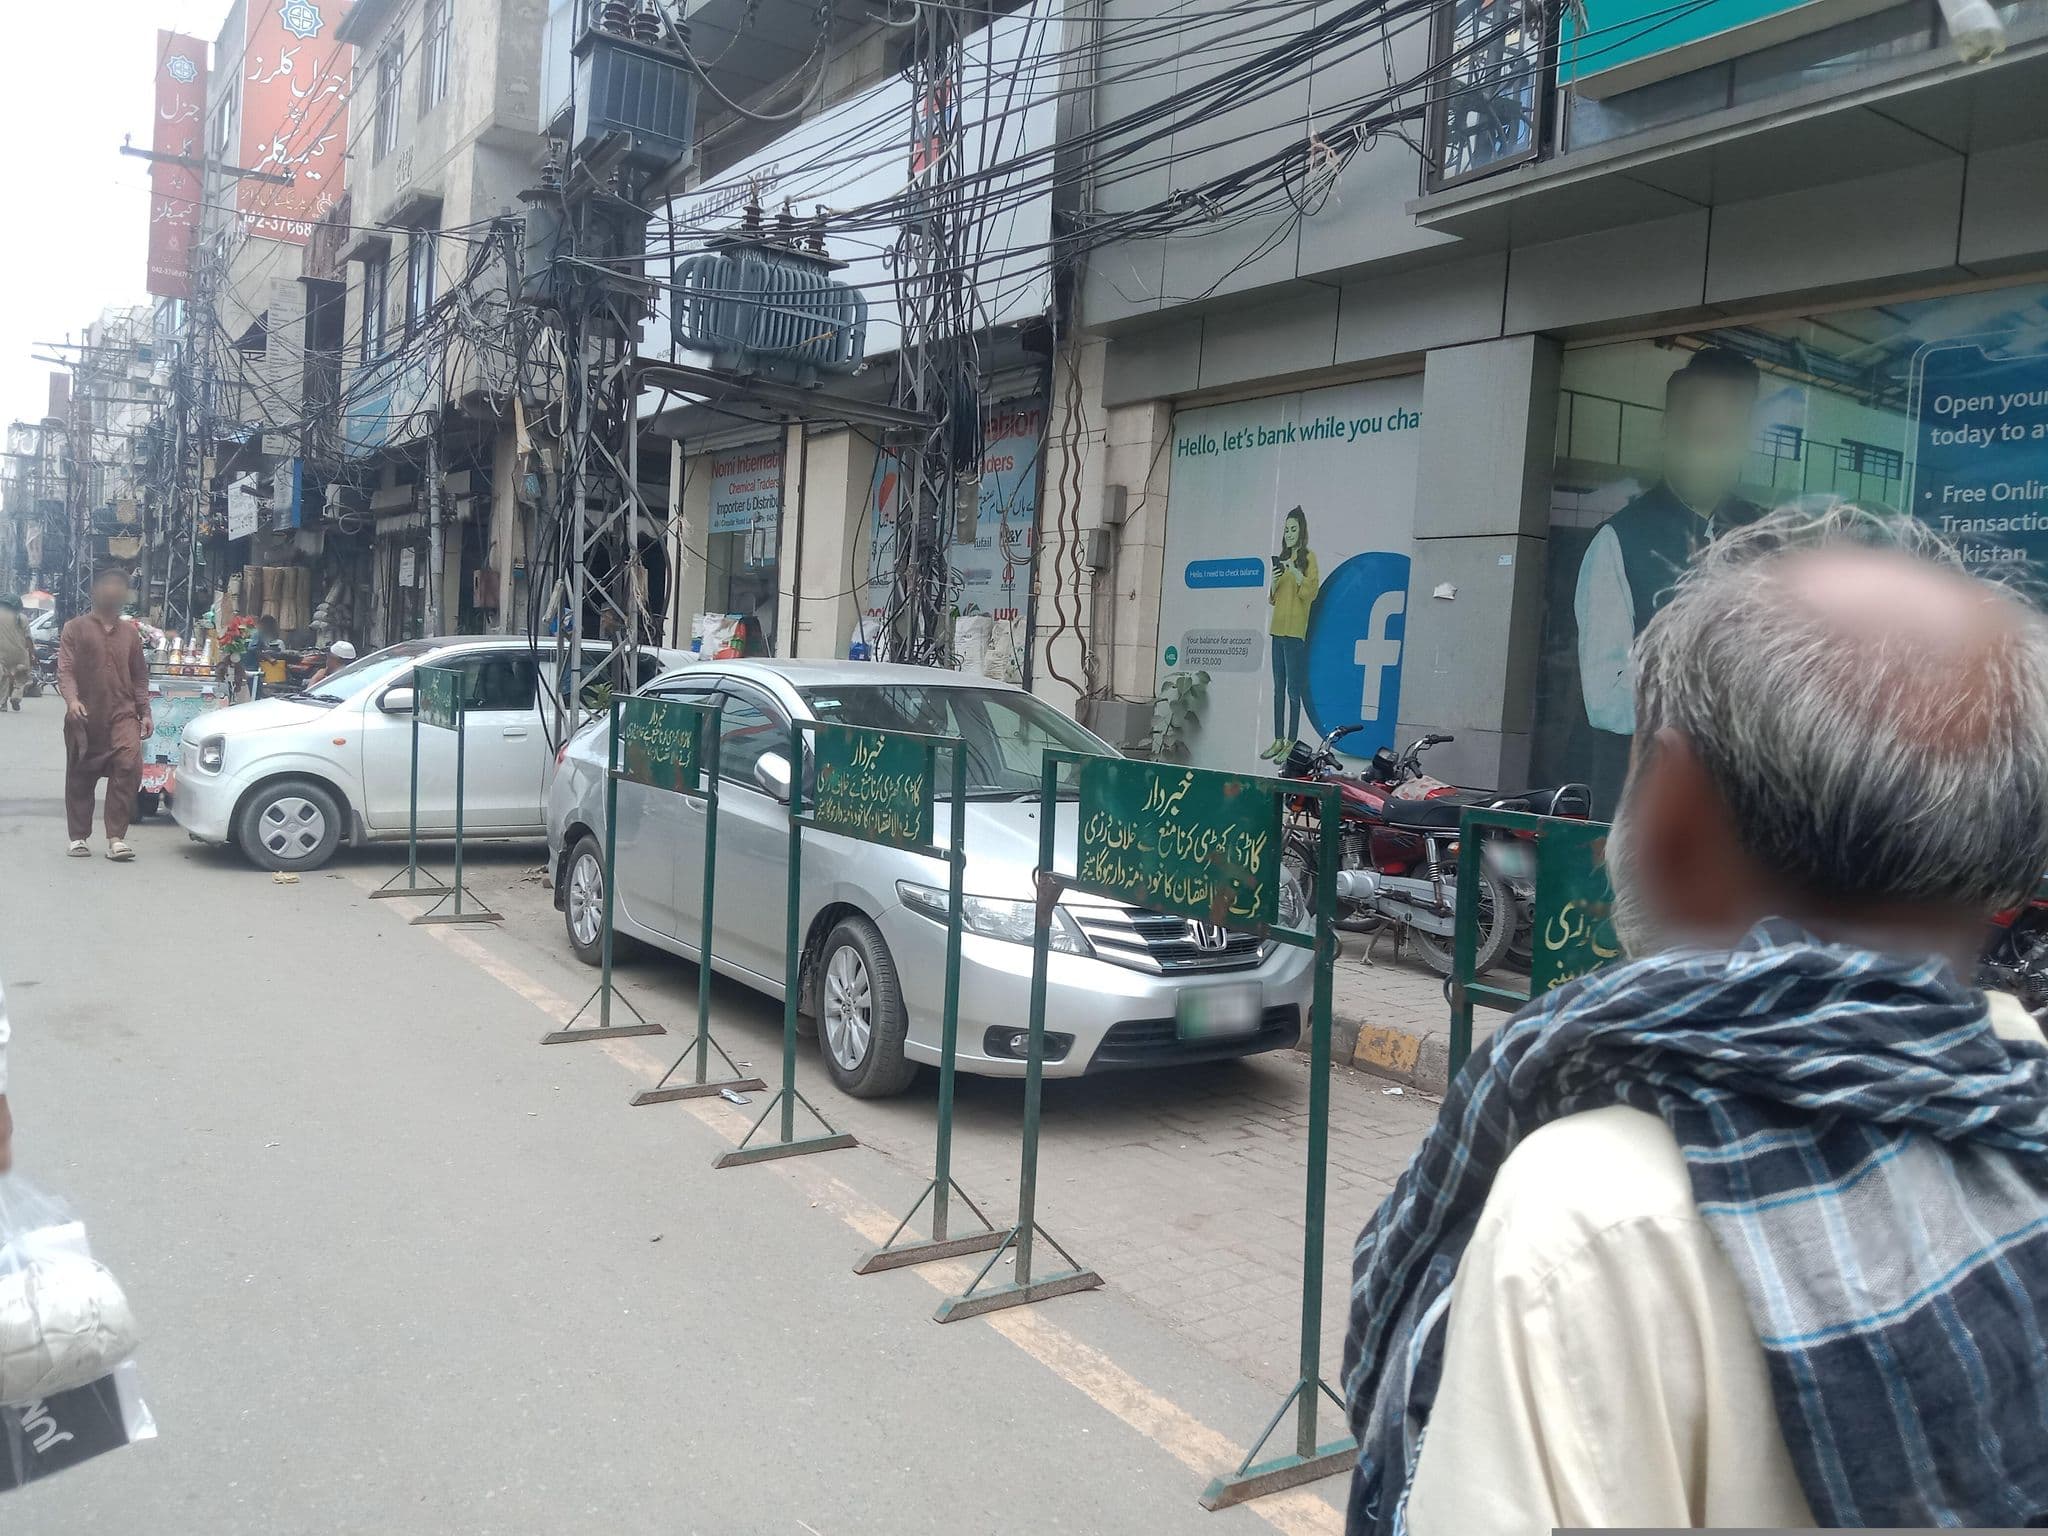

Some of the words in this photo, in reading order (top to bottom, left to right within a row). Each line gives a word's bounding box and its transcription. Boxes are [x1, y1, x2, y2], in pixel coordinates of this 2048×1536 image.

[1933, 393, 1995, 418] Open
[1178, 434, 1220, 457] Hello,
[1223, 428, 1254, 451] let's
[1258, 421, 1296, 447] bank
[1299, 416, 1345, 442] while
[1347, 416, 1383, 443] you
[1387, 407, 1423, 431] cha
[1930, 424, 1996, 448] today
[2000, 422, 2026, 441] to
[1942, 484, 1987, 504] Free
[850, 735, 886, 773] خبردار
[1141, 771, 1195, 818] خبردار
